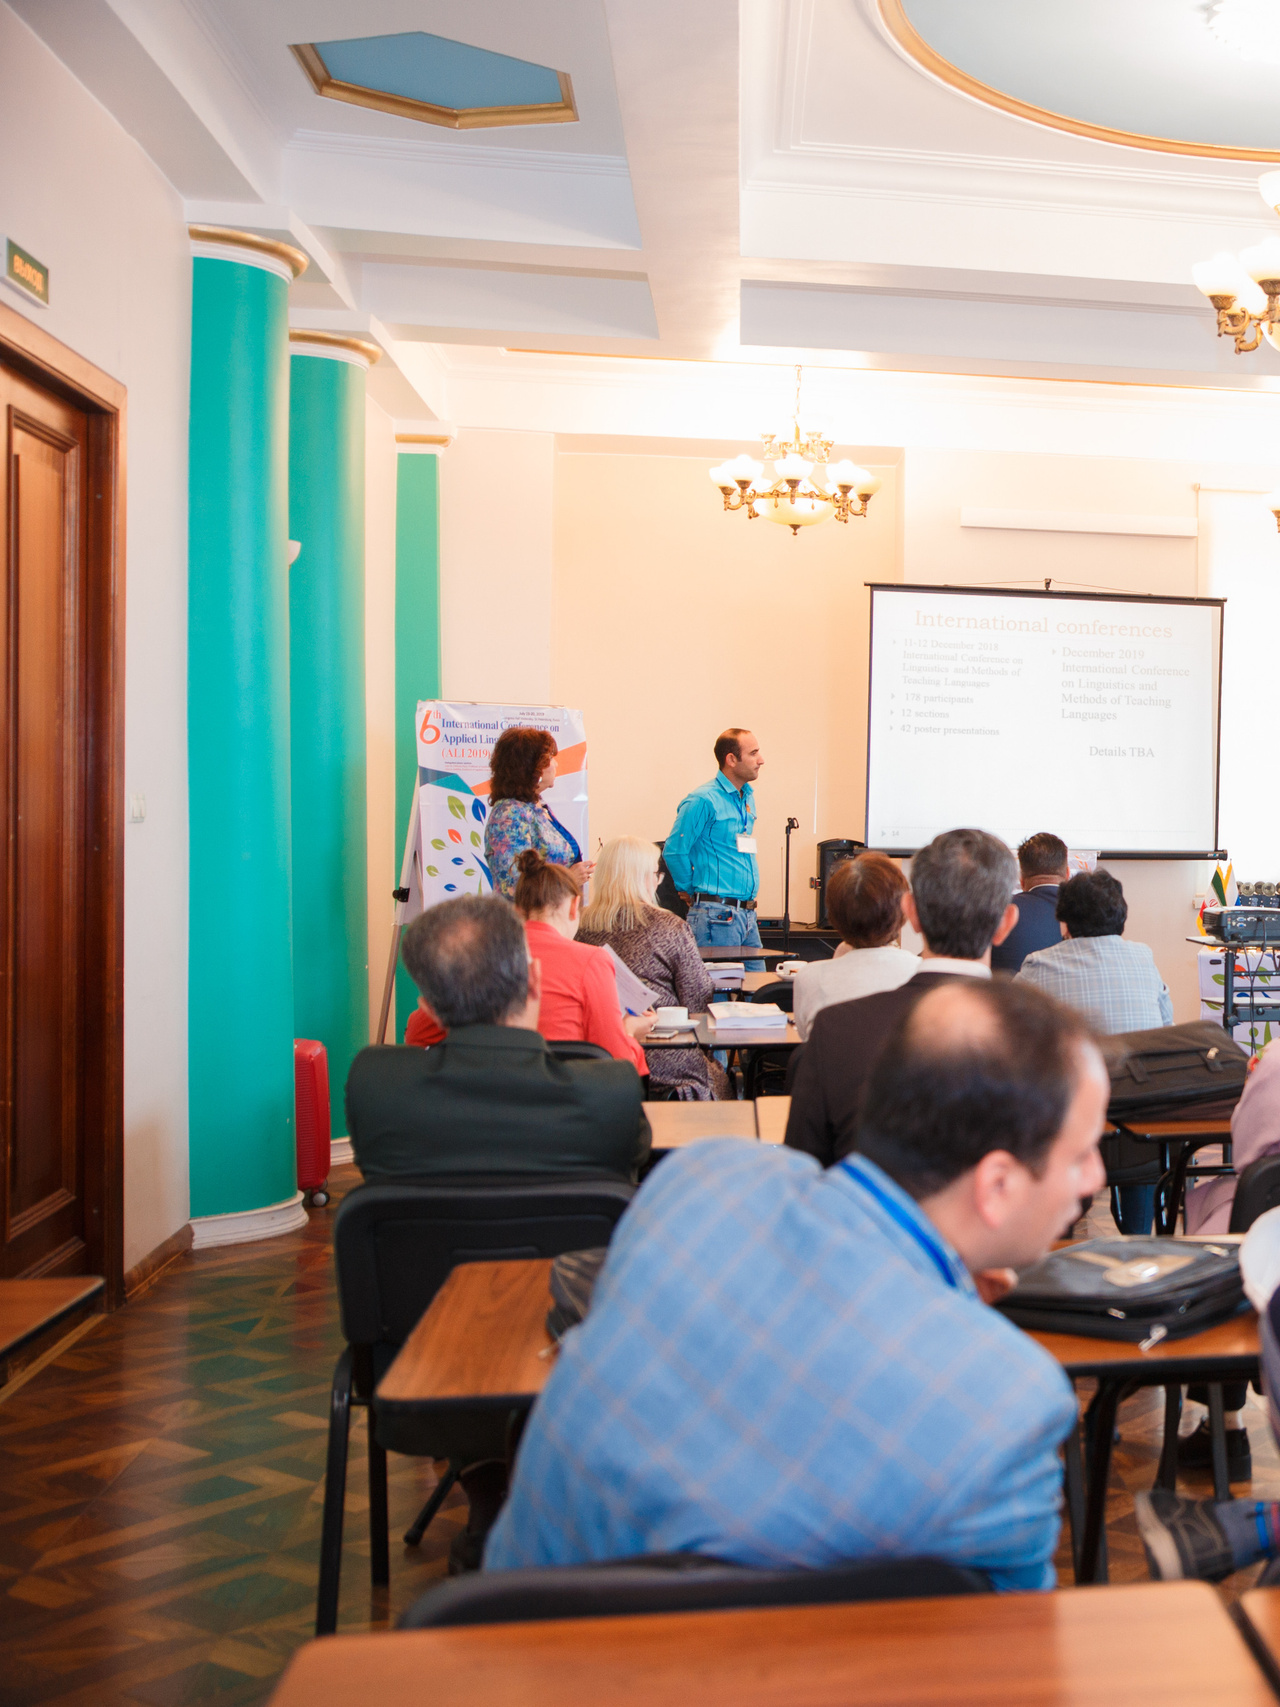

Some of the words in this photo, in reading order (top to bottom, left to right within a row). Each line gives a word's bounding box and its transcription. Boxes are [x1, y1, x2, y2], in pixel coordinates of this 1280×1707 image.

[915, 609, 1049, 633] International
[1056, 619, 1173, 638] conferences
[904, 638, 928, 648] 11-12
[930, 639, 974, 650] December
[978, 642, 999, 651] 2018
[903, 650, 958, 662] International
[961, 653, 1010, 664] Conference
[1012, 657, 1024, 665] on
[1062, 646, 1115, 659] December
[1118, 648, 1145, 660] 2019
[902, 662, 949, 674] Linguistics
[953, 666, 969, 674] and
[971, 666, 1008, 676] Methods
[1011, 668, 1021, 677] of
[1062, 662, 1127, 674] International
[1131, 664, 1190, 677] Conference
[902, 675, 941, 688] Teaching
[944, 677, 991, 689] Languages
[1061, 680, 1074, 689] on
[1078, 678, 1136, 692] Linguistics
[1138, 681, 1158, 691] and
[905, 692, 921, 702] 178
[923, 693, 974, 705] participants
[1061, 693, 1108, 705] Methods
[1110, 695, 1122, 705] of
[1124, 695, 1172, 709] Teaching
[901, 708, 912, 717] 12
[914, 709, 950, 719] sections
[1061, 708, 1118, 722] Languages
[442, 718, 499, 731] International
[550, 725, 560, 733] on
[900, 724, 911, 733] 42
[914, 725, 941, 735] poster
[943, 727, 1000, 736] presentations
[442, 733, 477, 746] Applied
[1089, 745, 1127, 757] Details
[1128, 746, 1155, 758] TBA
